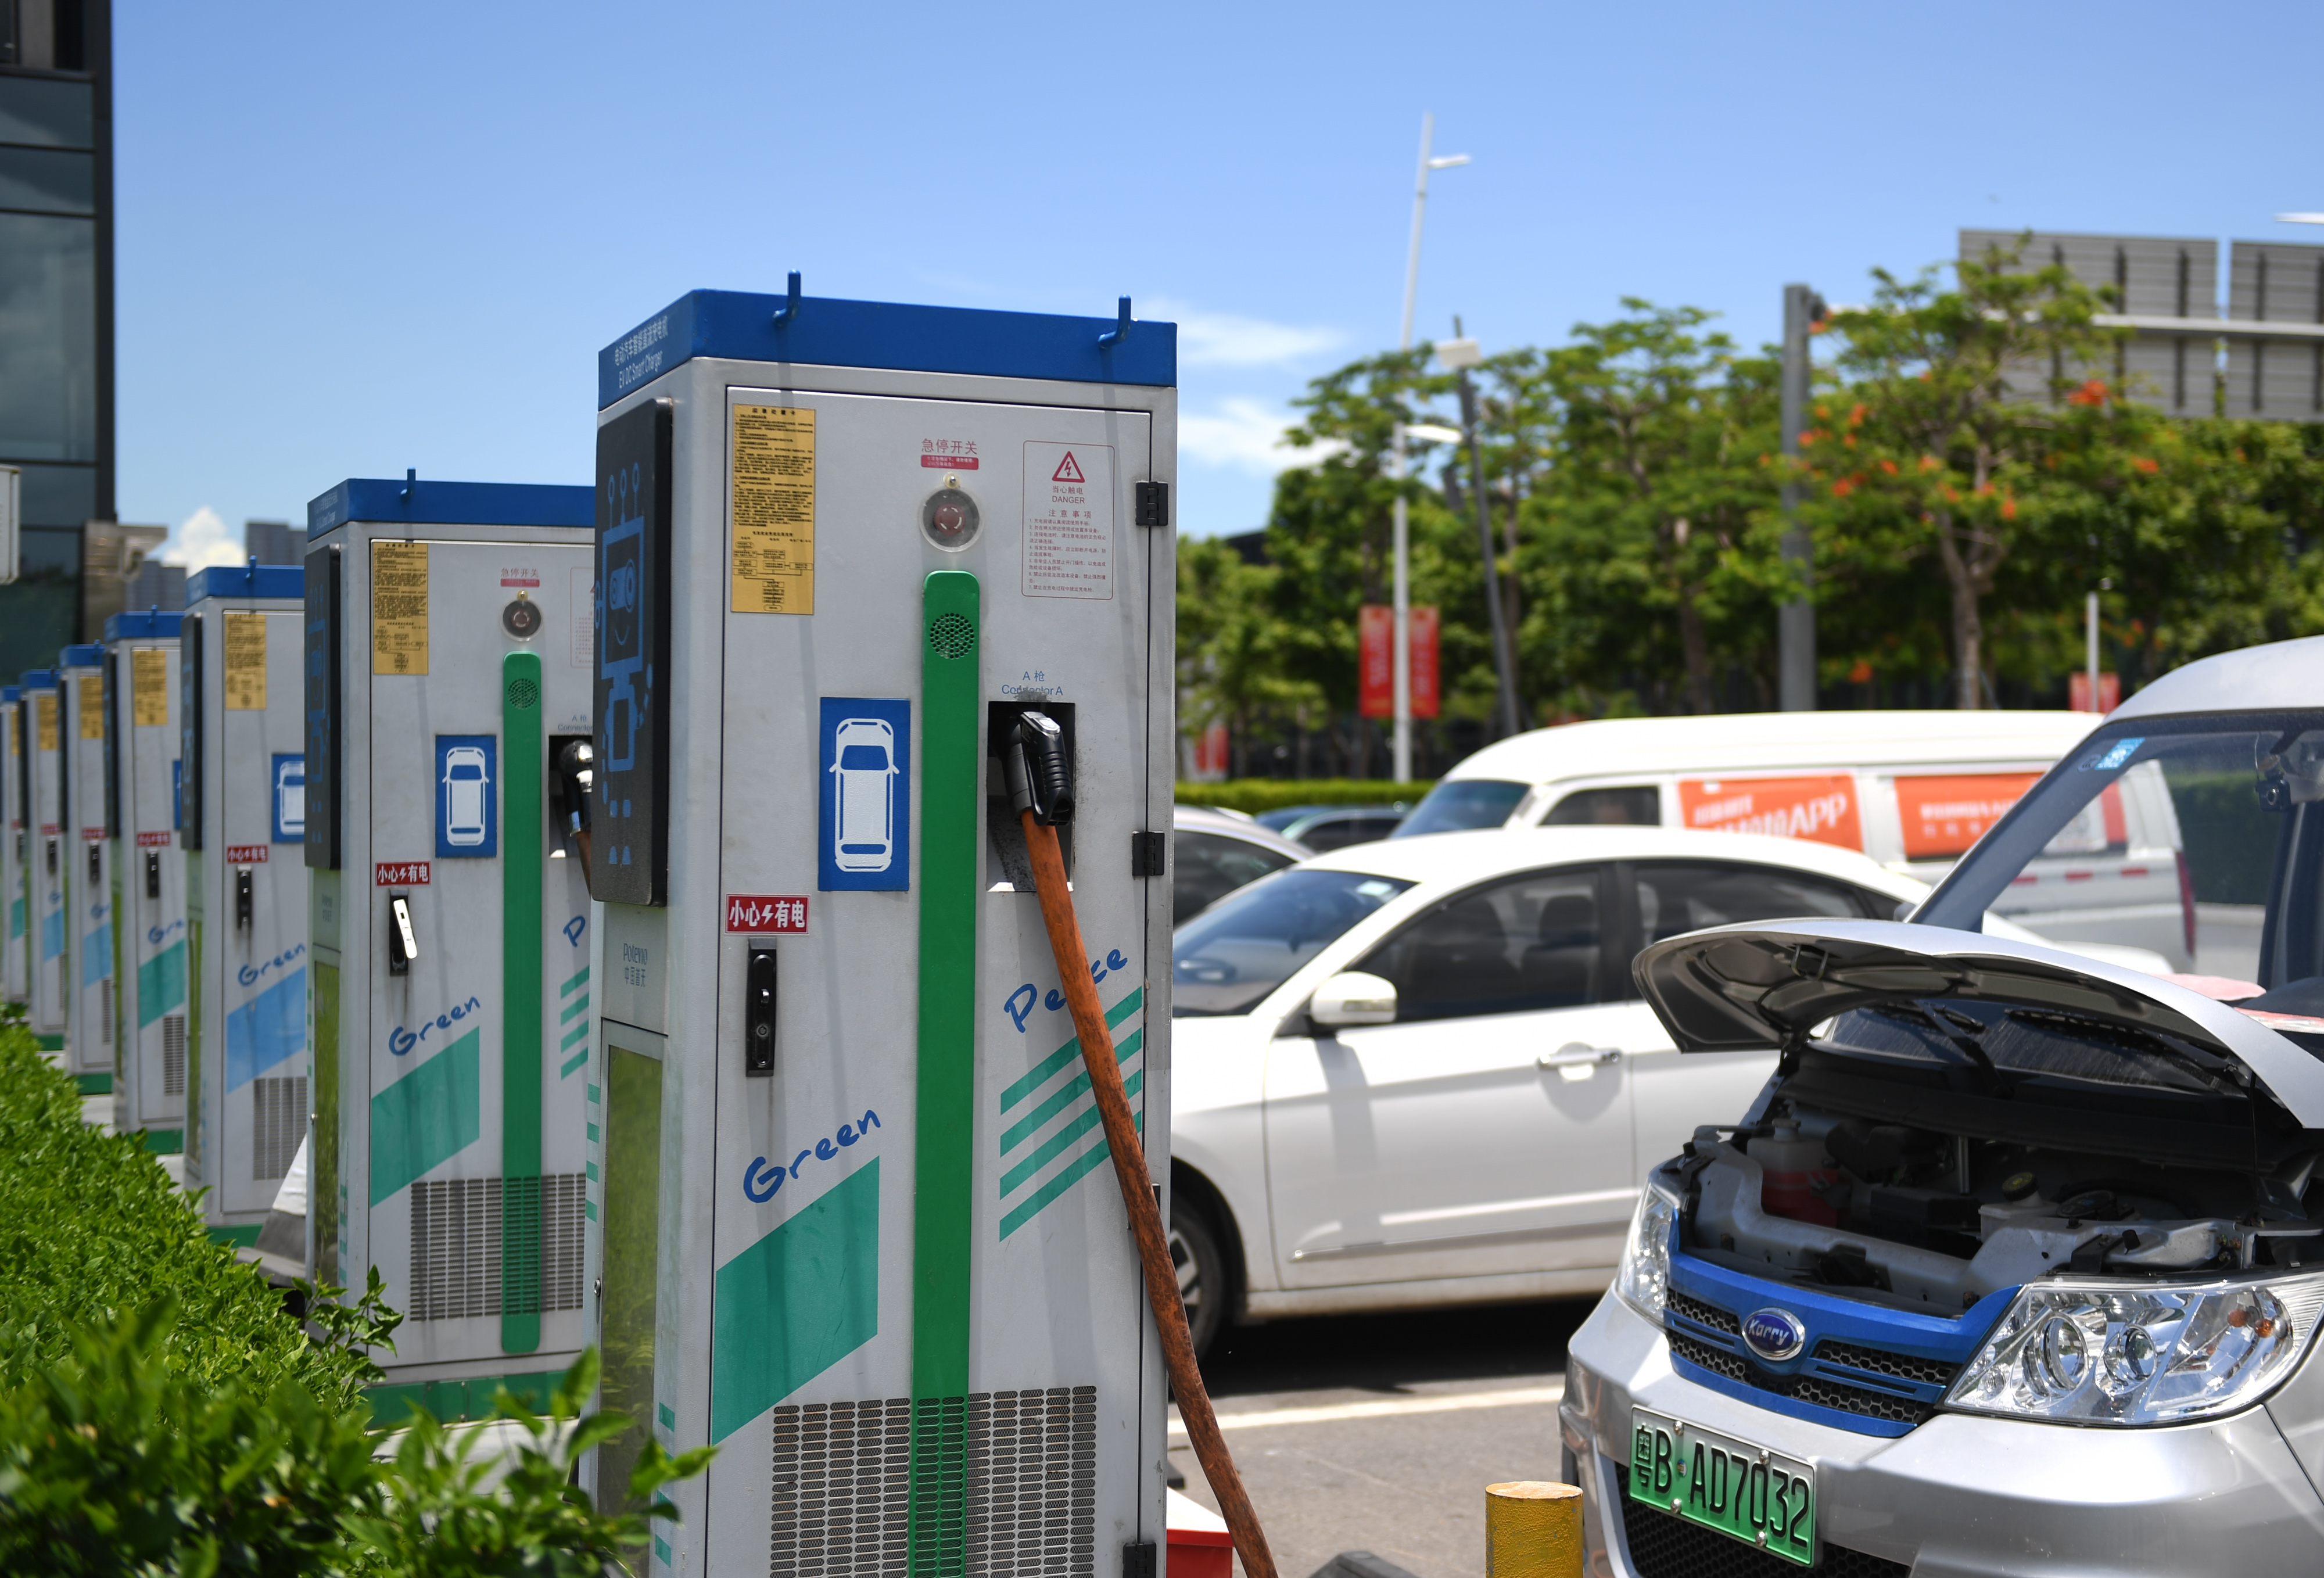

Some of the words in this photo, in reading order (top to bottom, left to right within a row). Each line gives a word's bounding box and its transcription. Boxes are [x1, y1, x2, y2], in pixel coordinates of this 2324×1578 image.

[921, 438, 977, 454] 急停开关
[1052, 486, 1084, 494] 当心触电
[1052, 496, 1085, 504] DANGER
[1048, 509, 1092, 519] 注意事项
[1023, 671, 1031, 680] A
[1034, 670, 1045, 682] 枪
[1056, 686, 1063, 695] A
[238, 942, 306, 987] Green
[1004, 949, 1128, 1033] Pece
[388, 996, 480, 1056] Green
[743, 1110, 881, 1203] Green
[1748, 1319, 1789, 1346] Karry
